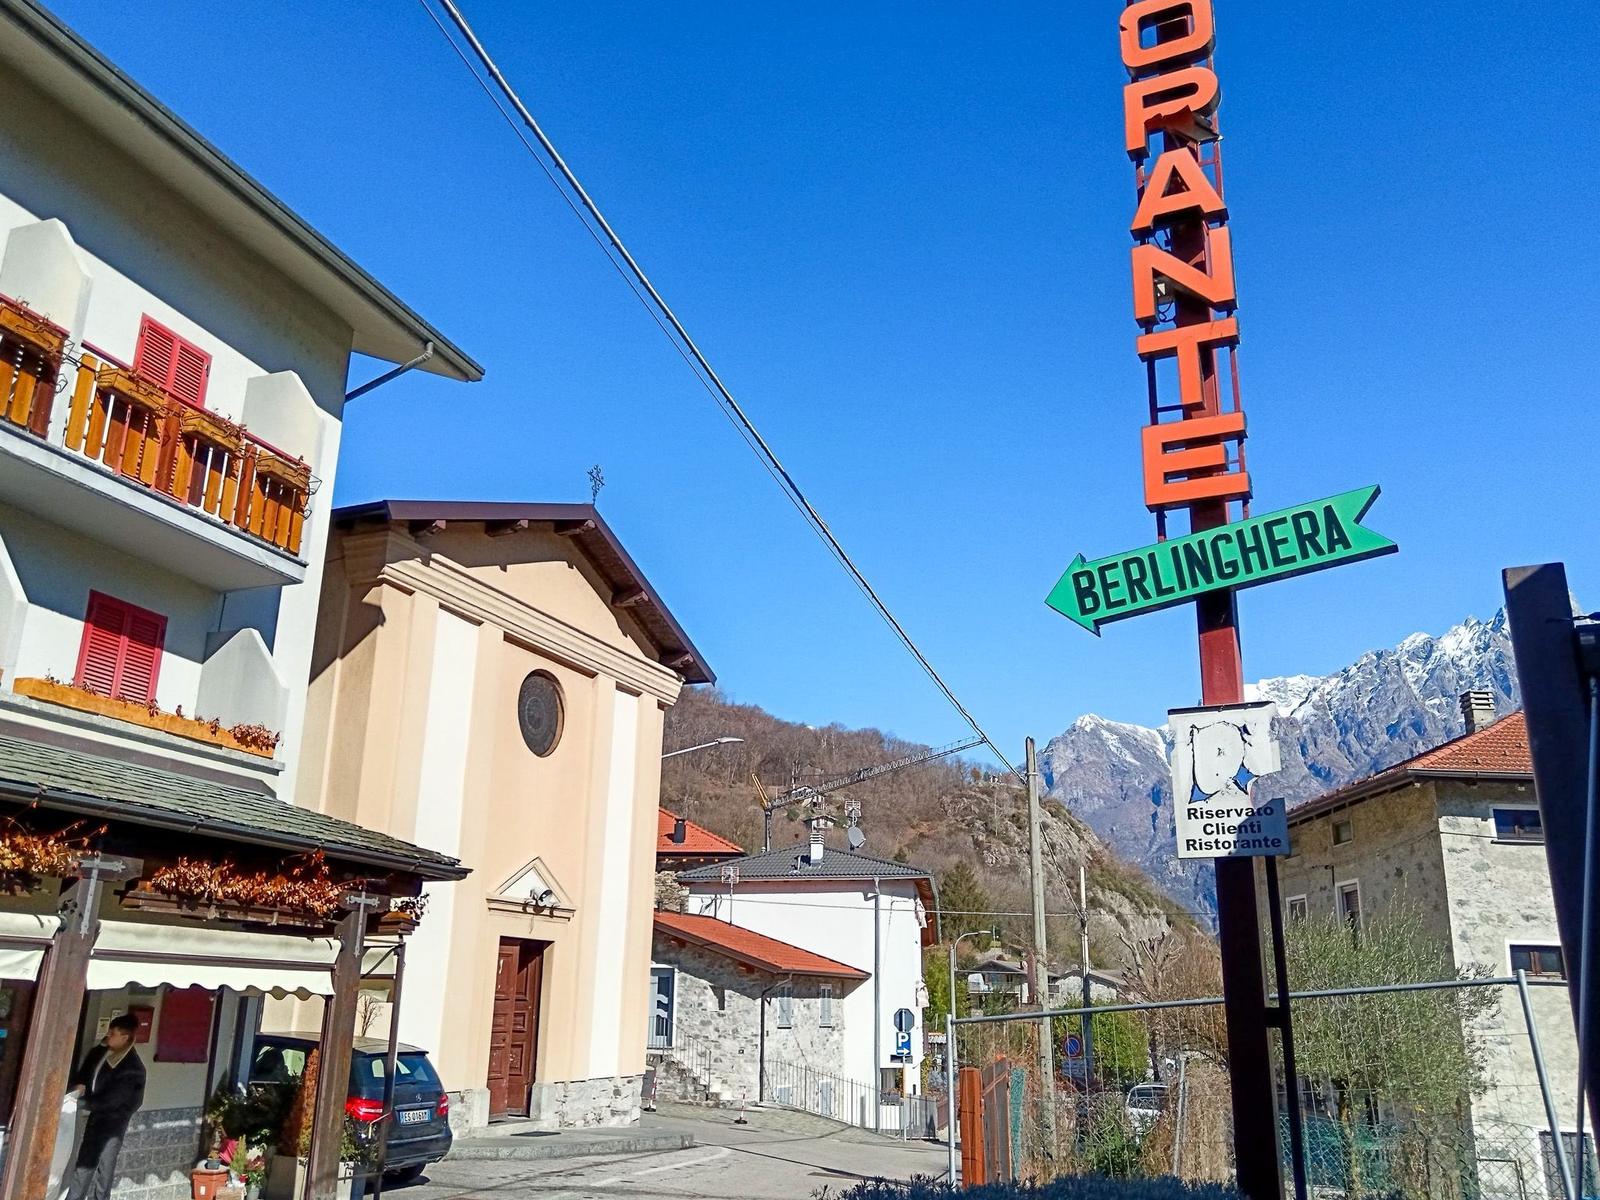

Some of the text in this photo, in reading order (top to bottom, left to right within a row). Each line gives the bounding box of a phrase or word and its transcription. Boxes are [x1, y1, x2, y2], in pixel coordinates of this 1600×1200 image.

[1071, 504, 1352, 616] BERLINGHERA
[1202, 822, 1262, 836] Clienti
[1186, 836, 1281, 851] Ristorante
[898, 1033, 909, 1047] P
